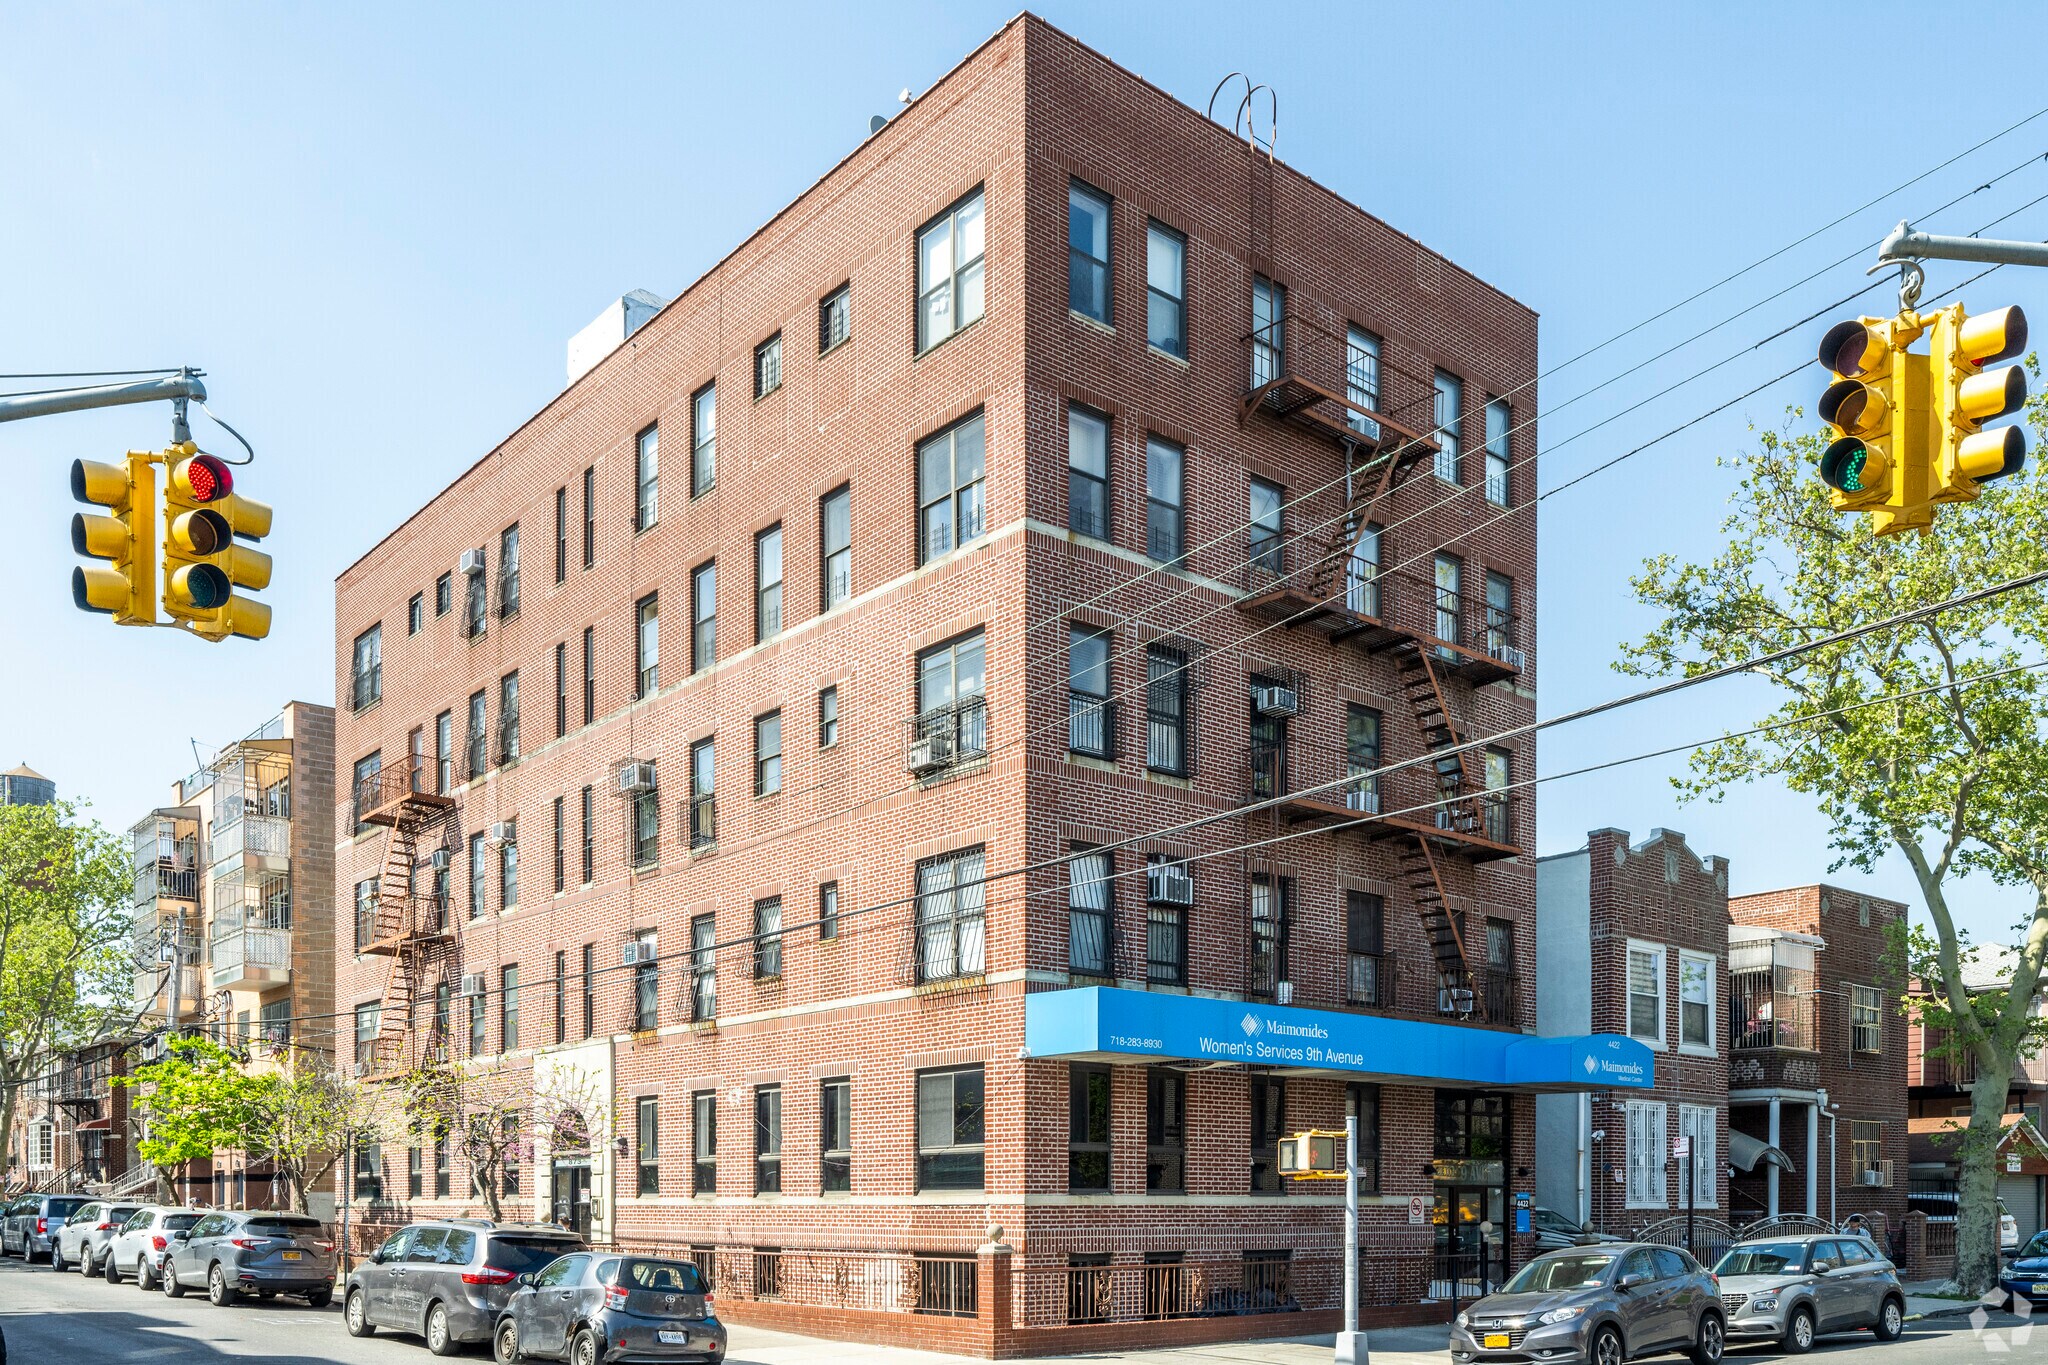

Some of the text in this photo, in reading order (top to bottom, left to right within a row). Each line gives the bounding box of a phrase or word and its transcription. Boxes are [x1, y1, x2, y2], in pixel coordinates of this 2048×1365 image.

[1266, 1019, 1328, 1039] Maimonides
[1110, 1035, 1163, 1049] 718-283-8930
[1608, 1040, 1621, 1050] 4422
[1199, 1036, 1364, 1066] Women's Services 9th Avenue
[1601, 1059, 1643, 1075] Maimonides
